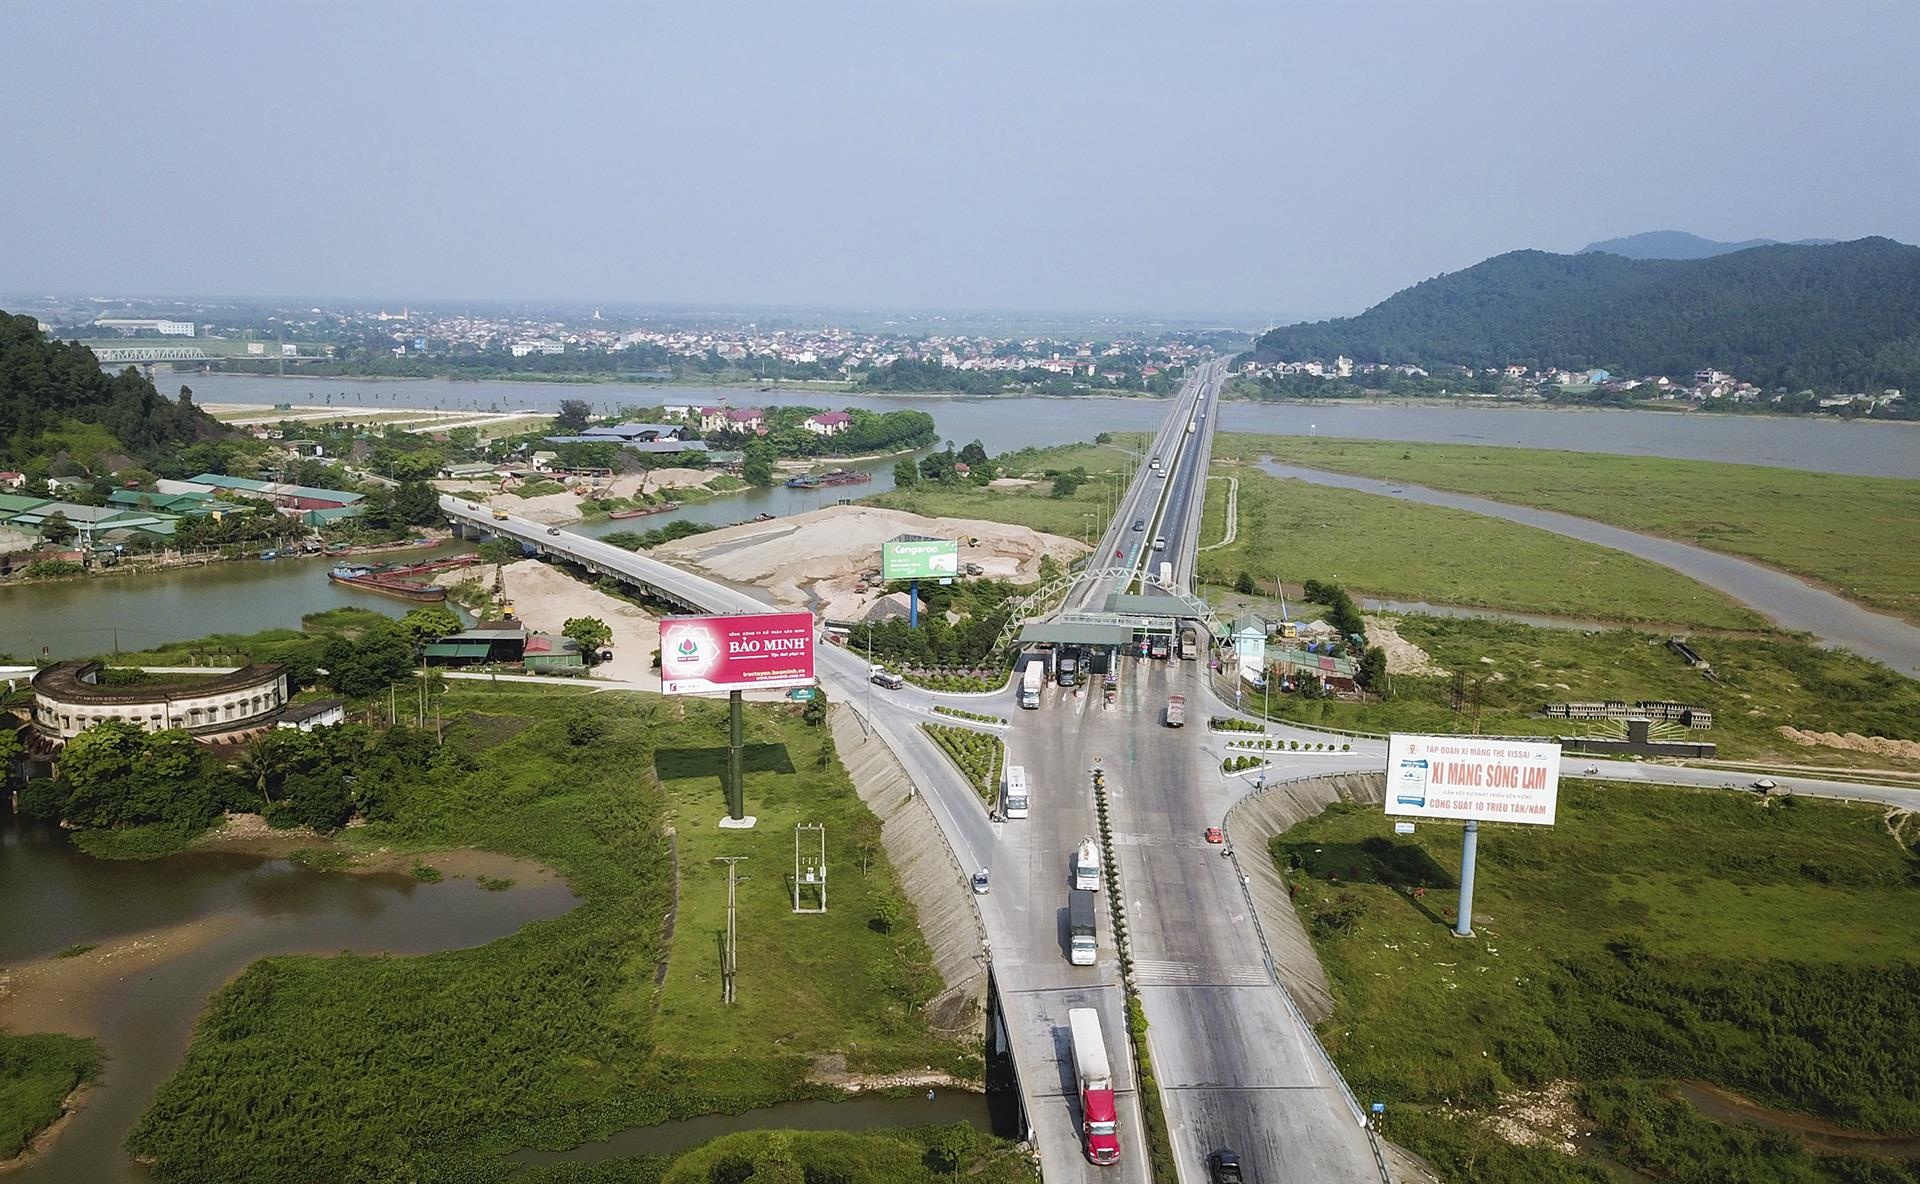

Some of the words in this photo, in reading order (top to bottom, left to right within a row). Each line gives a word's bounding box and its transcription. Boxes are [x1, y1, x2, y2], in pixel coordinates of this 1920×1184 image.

[729, 637, 760, 653] BẢO
[764, 638, 805, 650] MINH
[1493, 749, 1505, 758] THE
[1507, 750, 1530, 759] VISSAI
[1431, 761, 1444, 785] XI
[1447, 759, 1482, 787] MĂNG
[1486, 761, 1519, 789] SÔNG
[1522, 767, 1547, 790] LAM
[1475, 802, 1484, 811] 10
